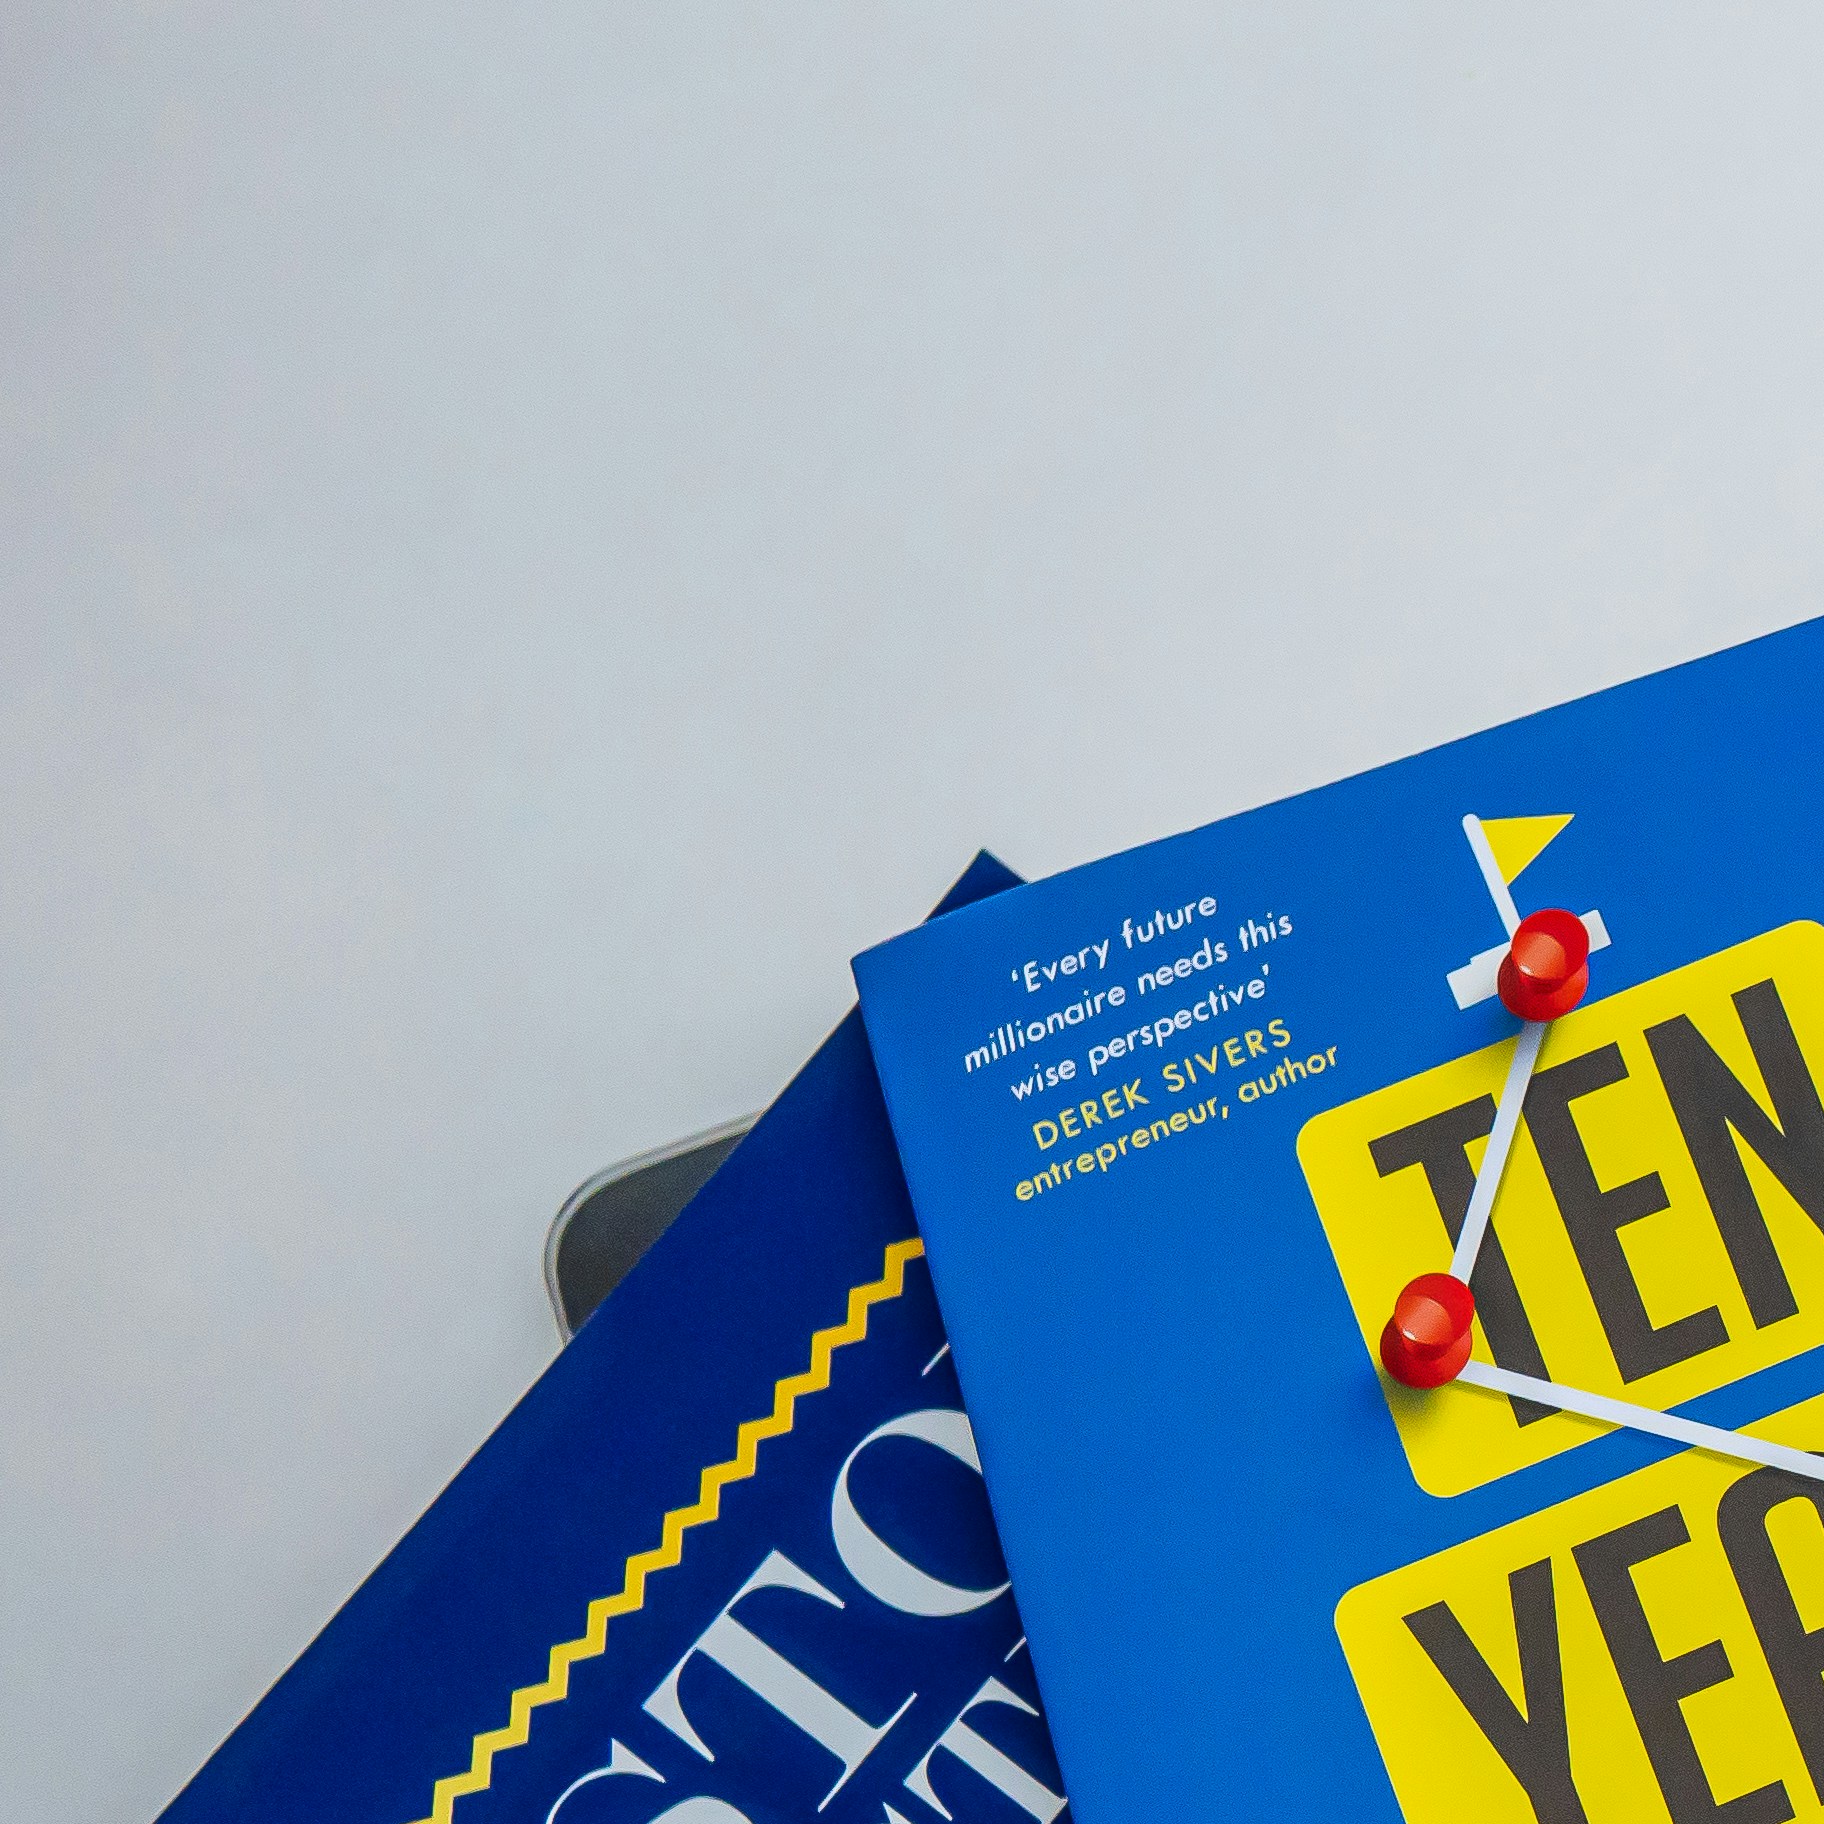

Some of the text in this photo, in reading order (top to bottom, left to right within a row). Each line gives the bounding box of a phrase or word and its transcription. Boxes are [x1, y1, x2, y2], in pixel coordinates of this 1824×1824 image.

[1121, 897, 1216, 949] future
[965, 913, 1292, 1072] millionaire needs this
[1011, 1060, 1075, 1100] wise
[1016, 1047, 1336, 1200] entrepreneur, author
[1033, 1019, 1290, 1150] DEREK SIVERS
